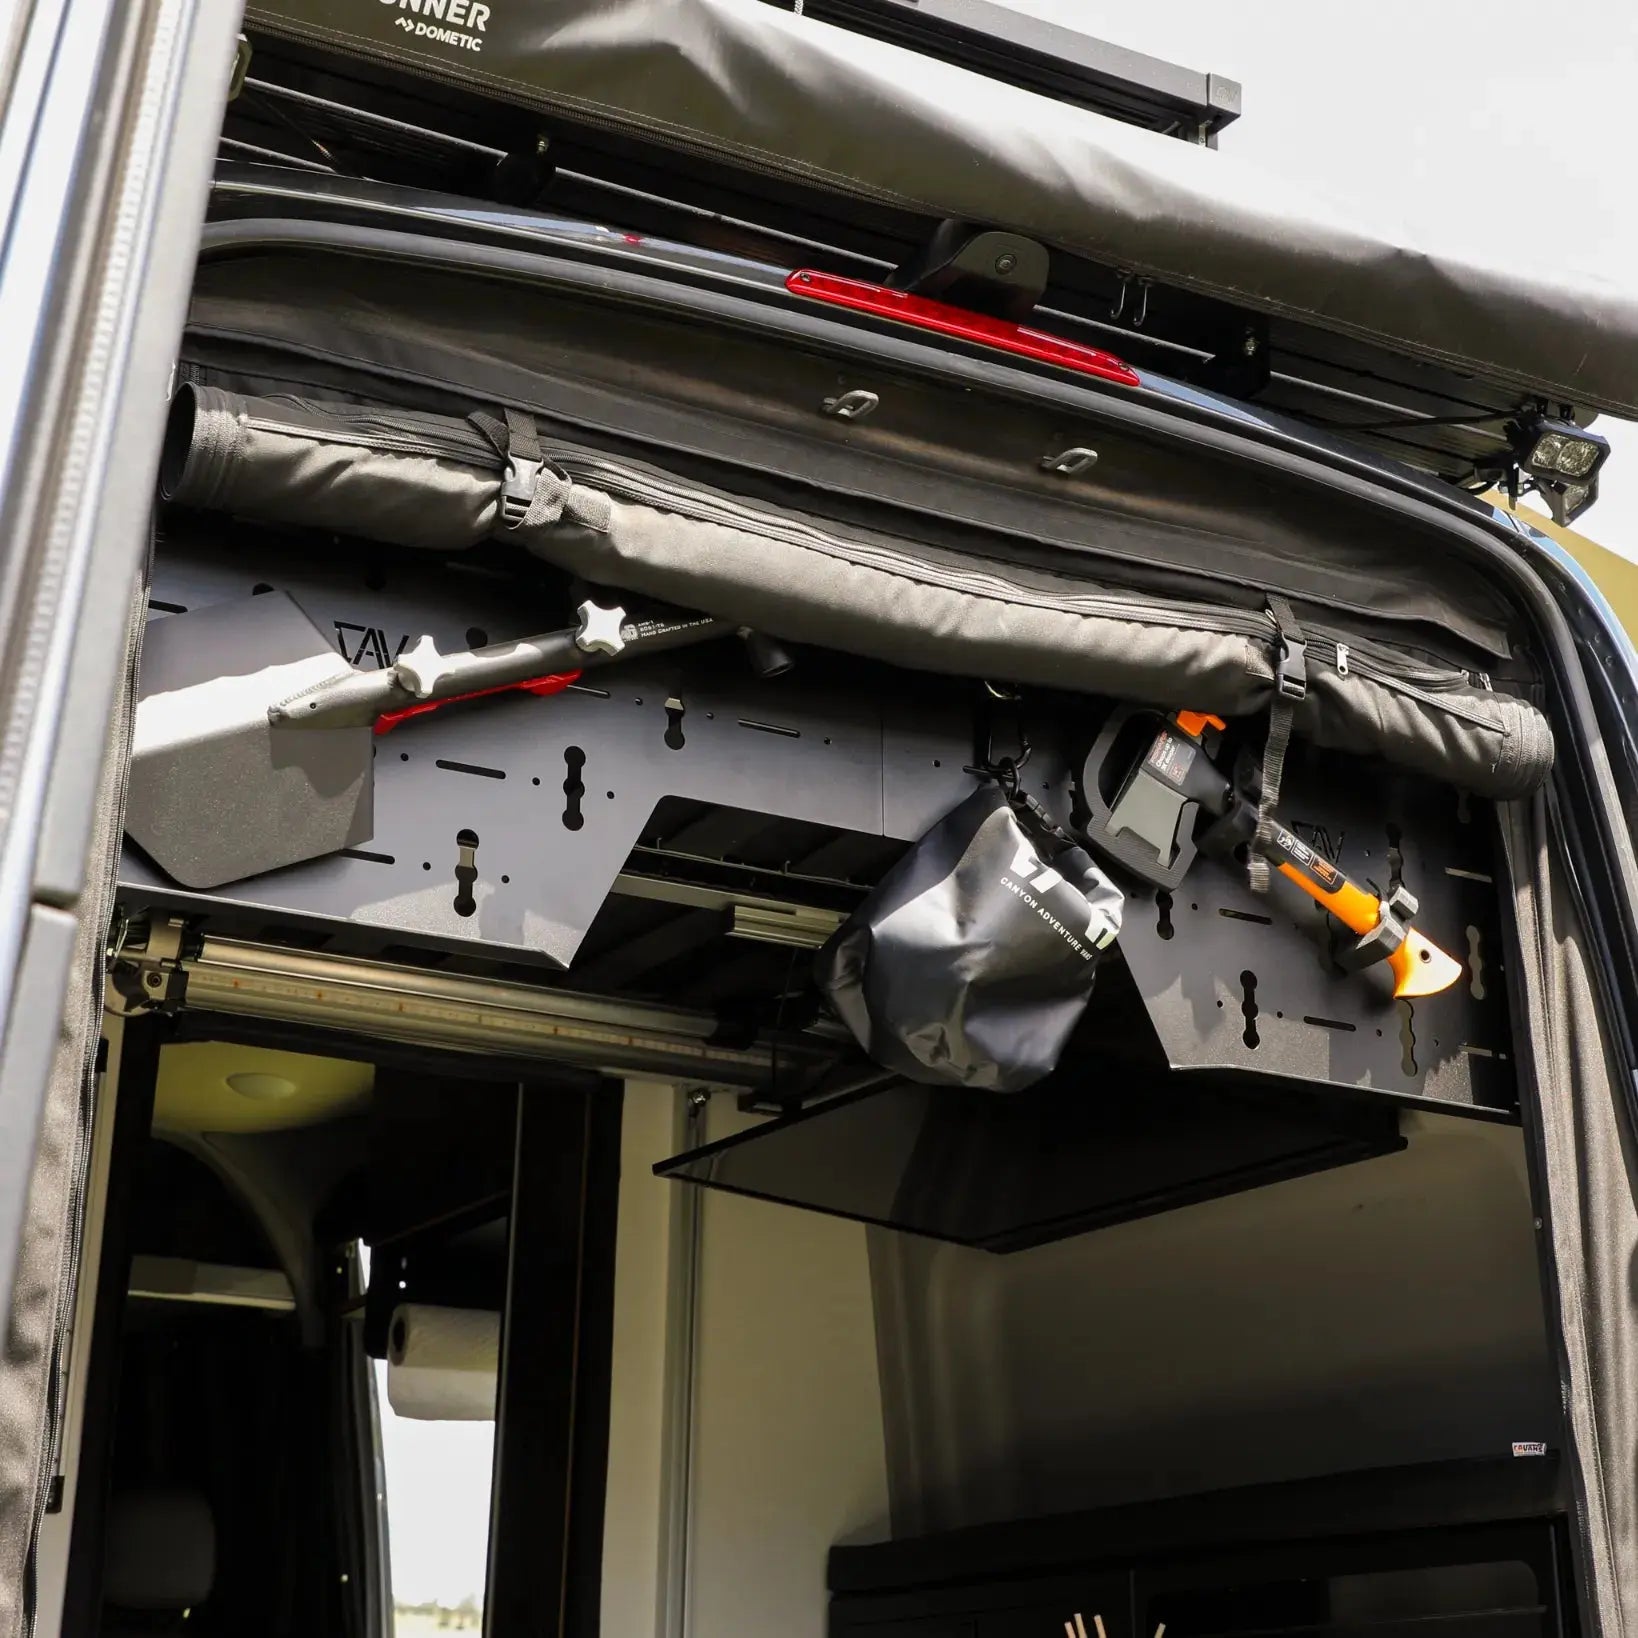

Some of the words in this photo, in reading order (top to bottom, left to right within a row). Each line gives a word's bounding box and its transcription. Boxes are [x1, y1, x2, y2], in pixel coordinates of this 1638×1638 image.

[379, 0, 491, 32] NER
[415, 22, 483, 52] DOMETIC
[1000, 876, 1038, 909] CANYON
[1037, 907, 1083, 952] ADVENTURE
